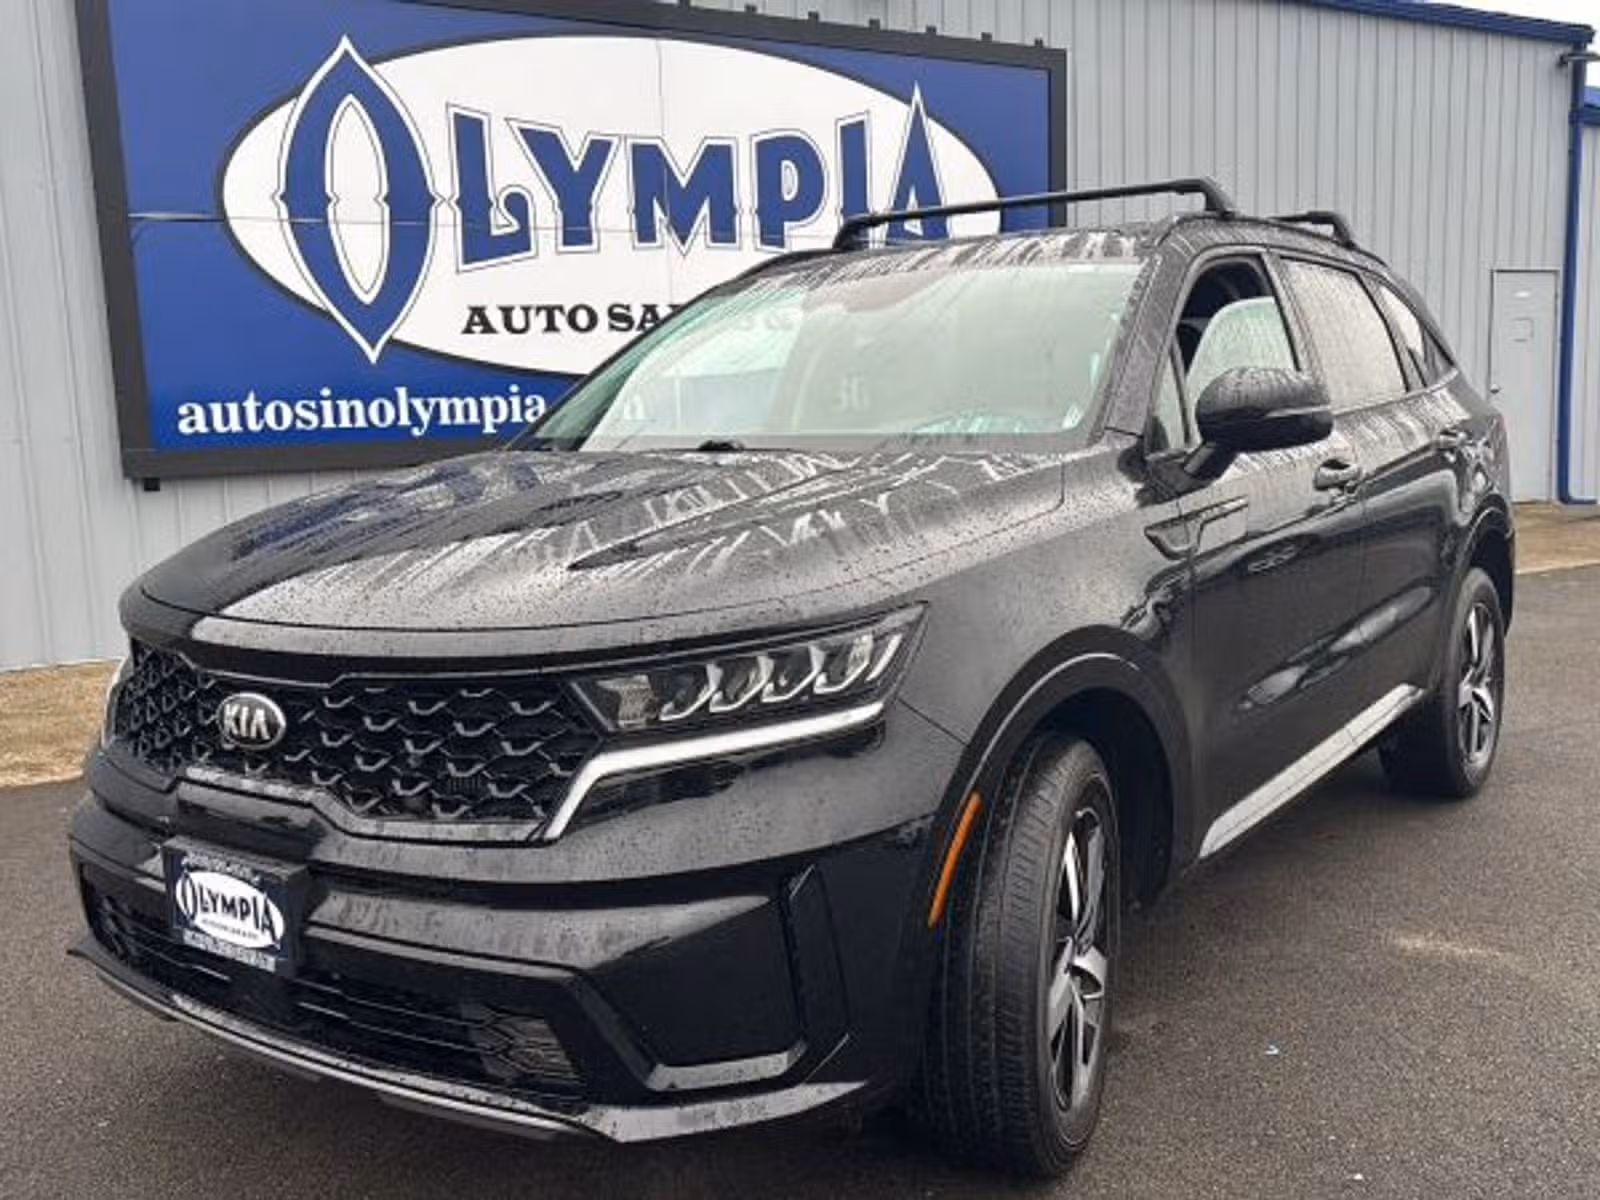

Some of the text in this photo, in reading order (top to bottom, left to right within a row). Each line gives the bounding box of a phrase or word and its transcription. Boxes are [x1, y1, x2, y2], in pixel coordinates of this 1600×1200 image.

[274, 34, 952, 364] OLYMPIA
[461, 304, 684, 334] AUTO SA
[177, 384, 546, 434] autosinolympia
[223, 703, 271, 740] KIA
[180, 871, 281, 949] OLYMPIA
